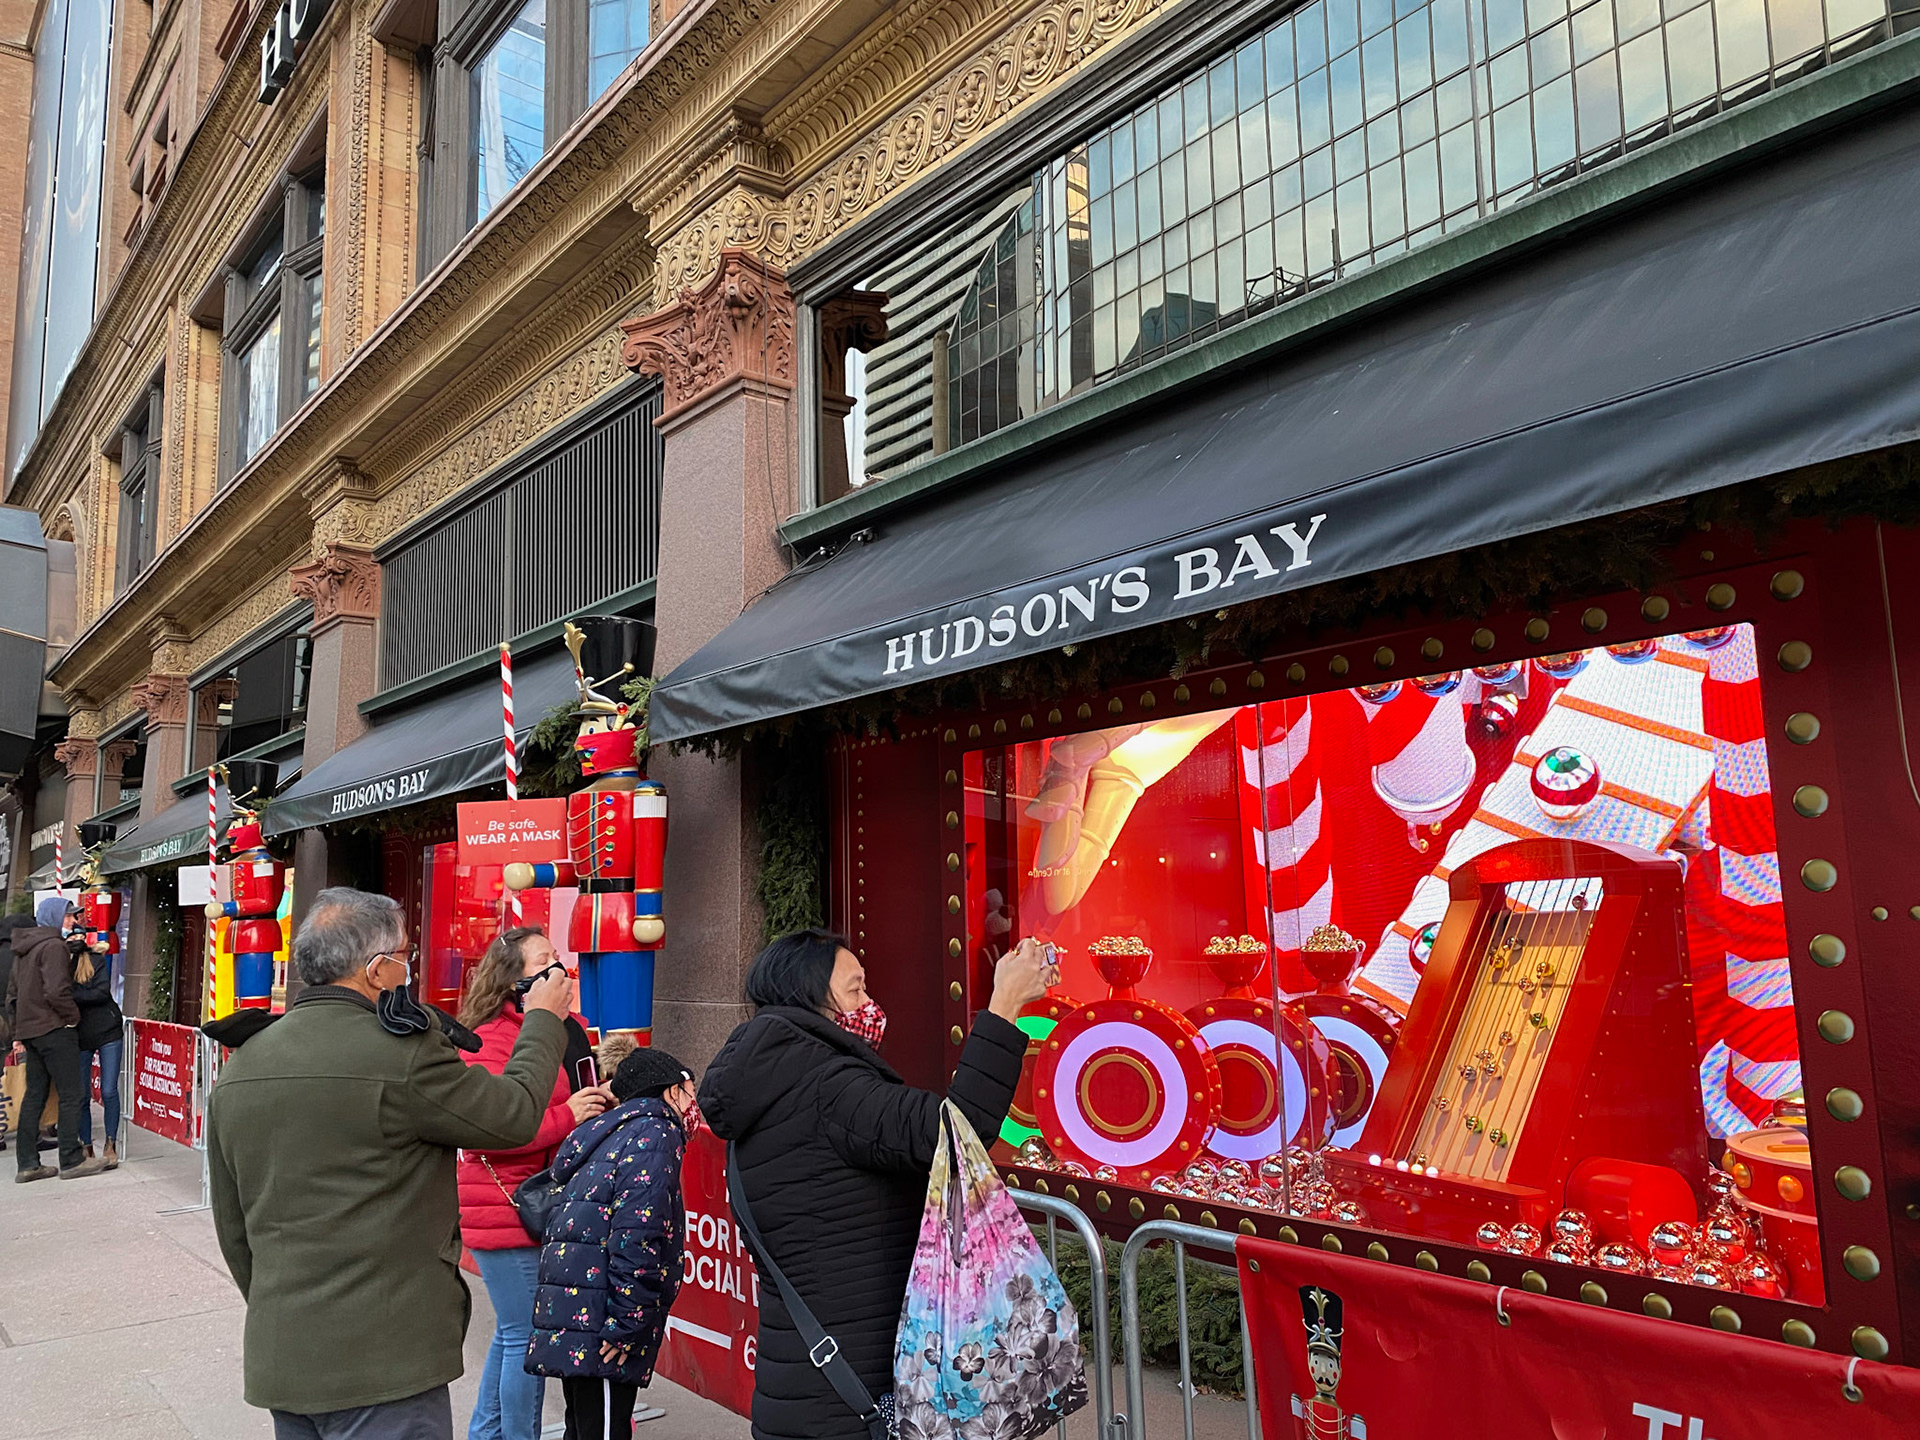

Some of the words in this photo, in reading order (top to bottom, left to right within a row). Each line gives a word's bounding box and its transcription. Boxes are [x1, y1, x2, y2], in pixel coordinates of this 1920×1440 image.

[882, 566, 1151, 676] HUDSON'S
[1172, 513, 1327, 601] BAY
[330, 778, 396, 815] HUDSON'S
[397, 769, 430, 798] BAY
[465, 832, 506, 846] WEAR
[509, 832, 520, 843] A
[522, 829, 561, 842] MASK
[487, 820, 505, 832] Be
[508, 818, 538, 830] safe.
[168, 839, 182, 856] BAY
[684, 1210, 731, 1254] FOR
[682, 1250, 747, 1304] OCIAL
